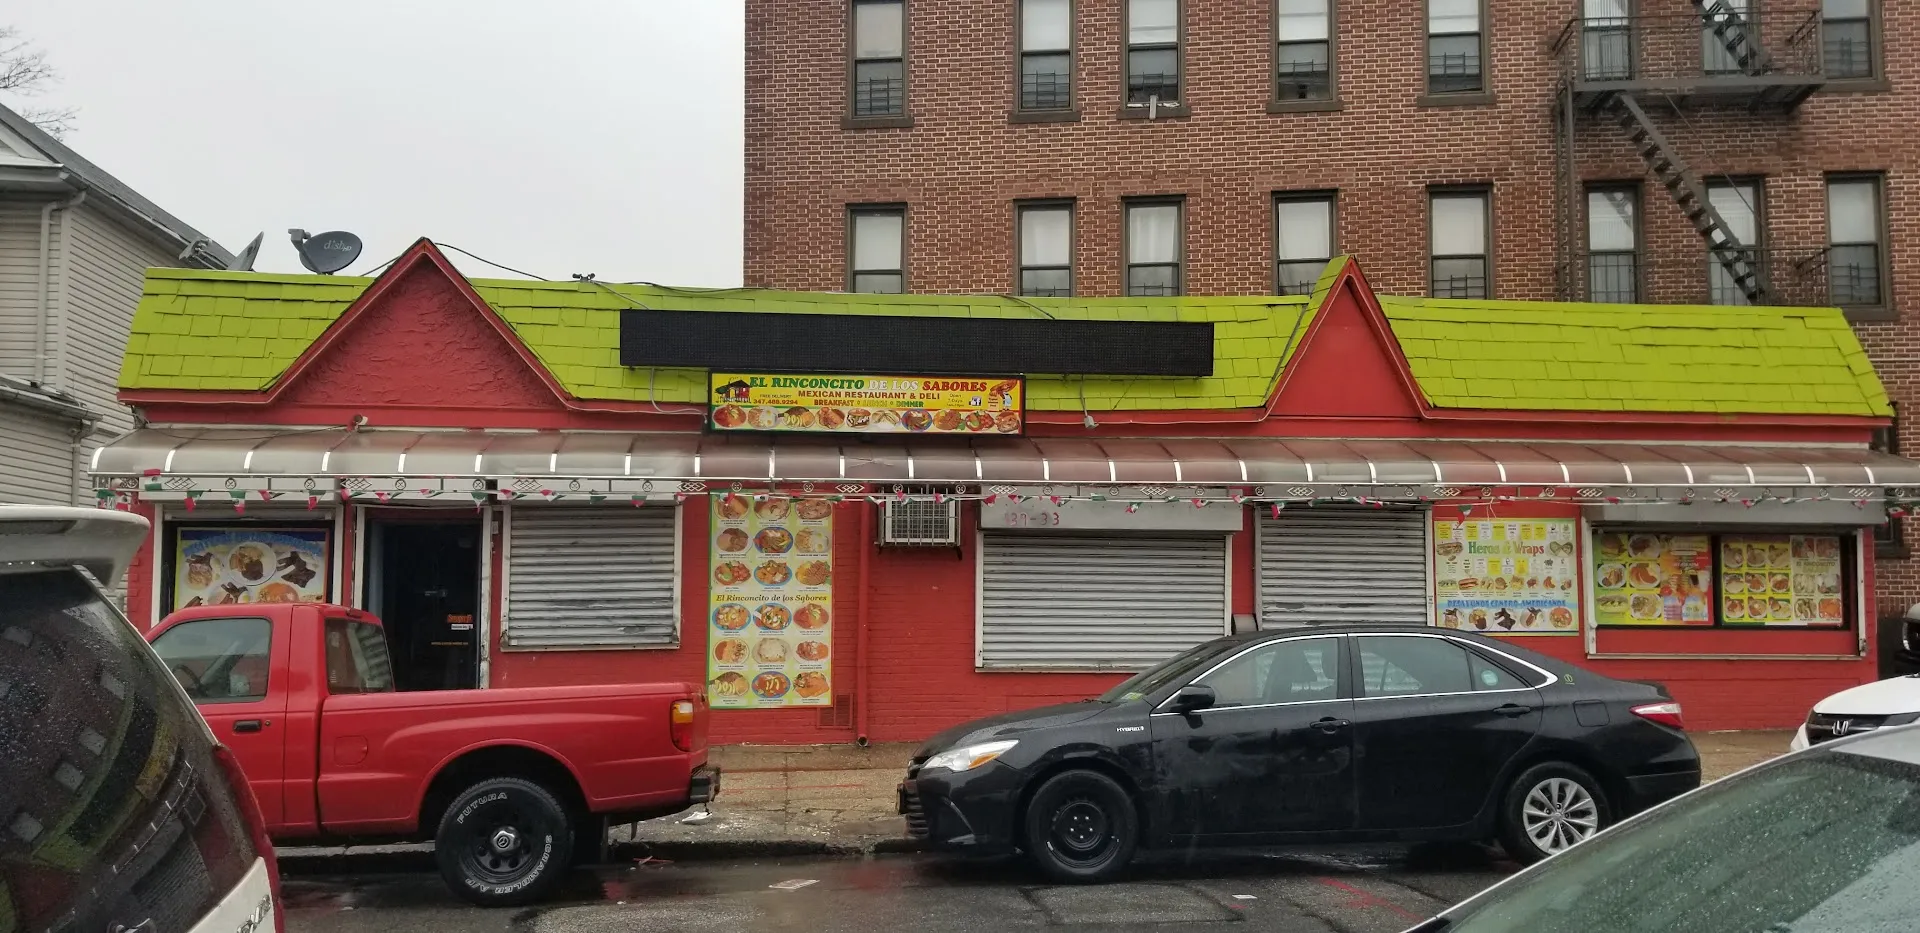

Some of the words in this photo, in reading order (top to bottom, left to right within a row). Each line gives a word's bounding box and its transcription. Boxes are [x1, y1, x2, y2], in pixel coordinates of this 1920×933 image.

[323, 240, 344, 250] dish
[749, 377, 768, 388] EL
[771, 377, 865, 390] RINCONCITO
[869, 379, 889, 391] DE
[891, 380, 919, 391] LOS
[922, 380, 988, 392] SABORES
[798, 390, 842, 398] MEXICAN
[844, 391, 907, 399] RESTAURANT
[1468, 541, 1500, 554] Heros
[1501, 541, 1511, 554] &
[1513, 541, 1545, 557] Wraps
[716, 594, 726, 602] El
[726, 594, 770, 602] Rinconcito
[771, 594, 781, 602] de
[782, 594, 794, 602] los
[794, 594, 827, 603] Sabores
[456, 792, 508, 824] FUTURA
[494, 834, 553, 894] SCRAMBLER
